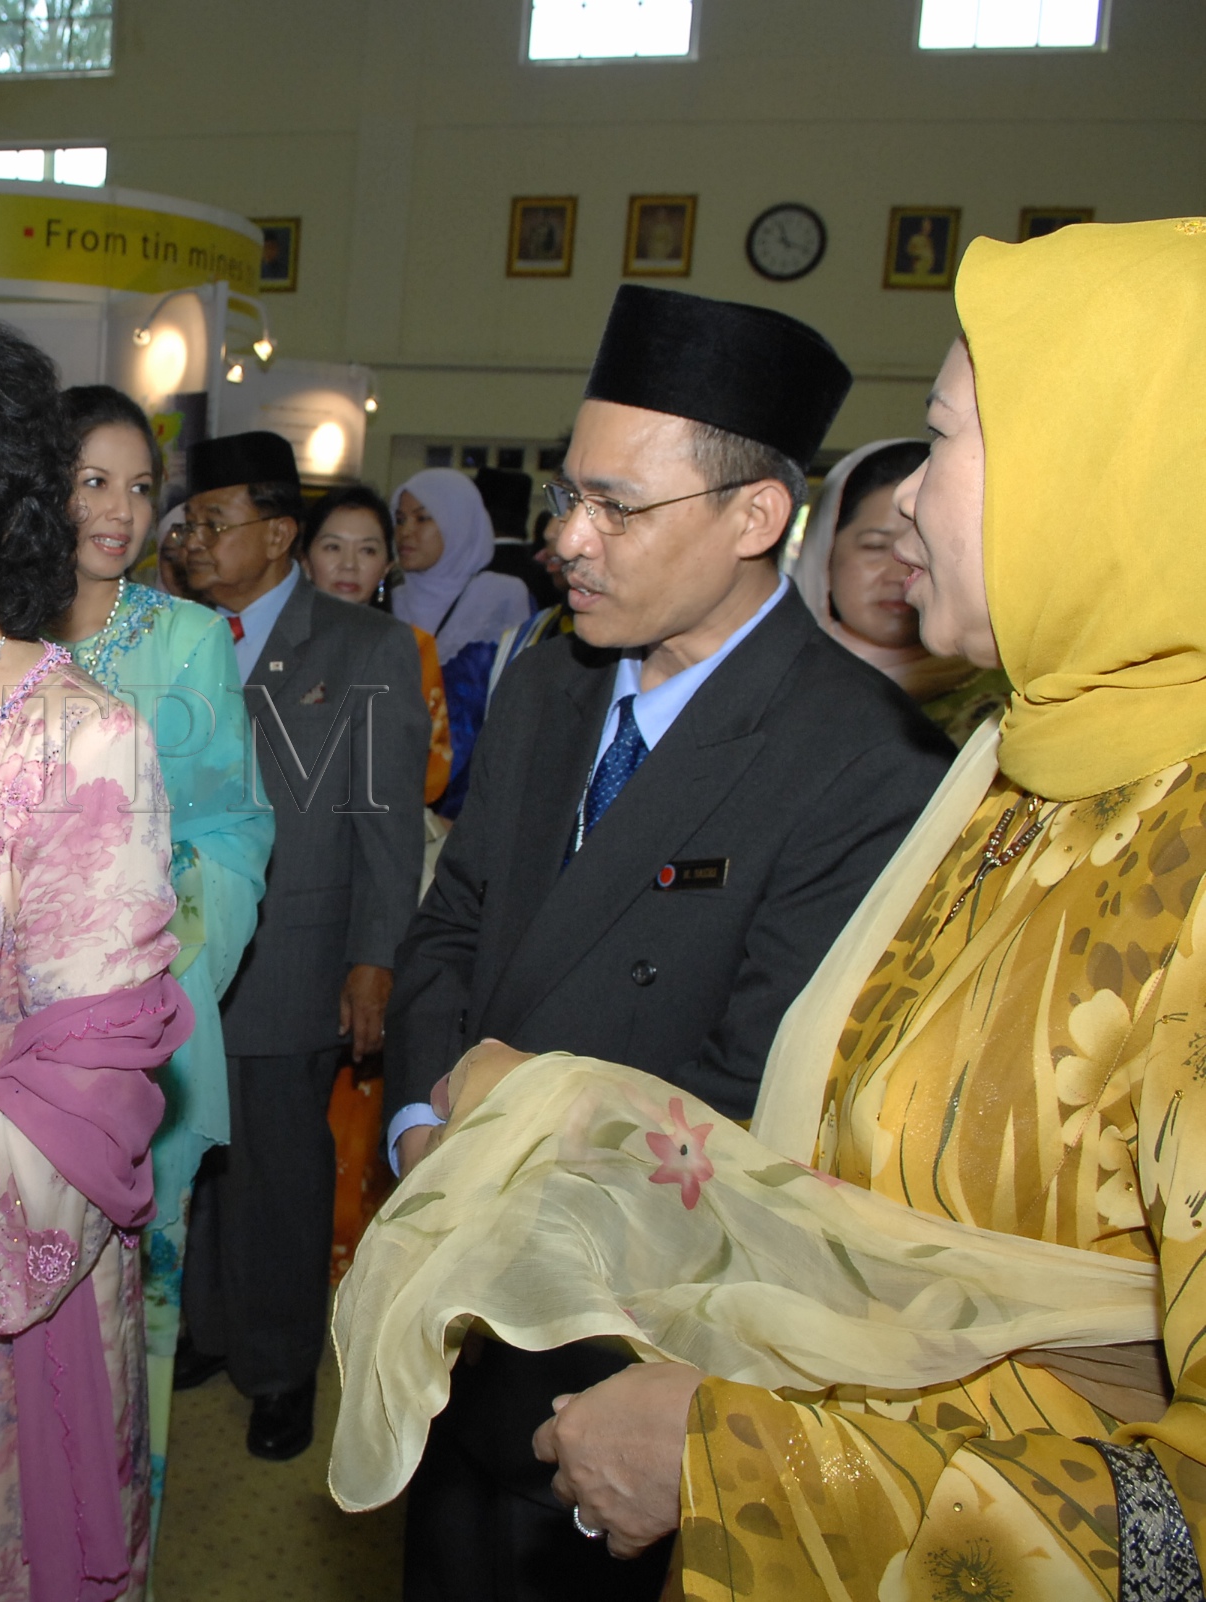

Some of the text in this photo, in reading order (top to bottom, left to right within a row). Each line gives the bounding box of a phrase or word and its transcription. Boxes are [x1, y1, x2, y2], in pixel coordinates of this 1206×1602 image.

[46, 218, 128, 256] From
[142, 232, 178, 263] tin
[188, 243, 245, 282] mines
